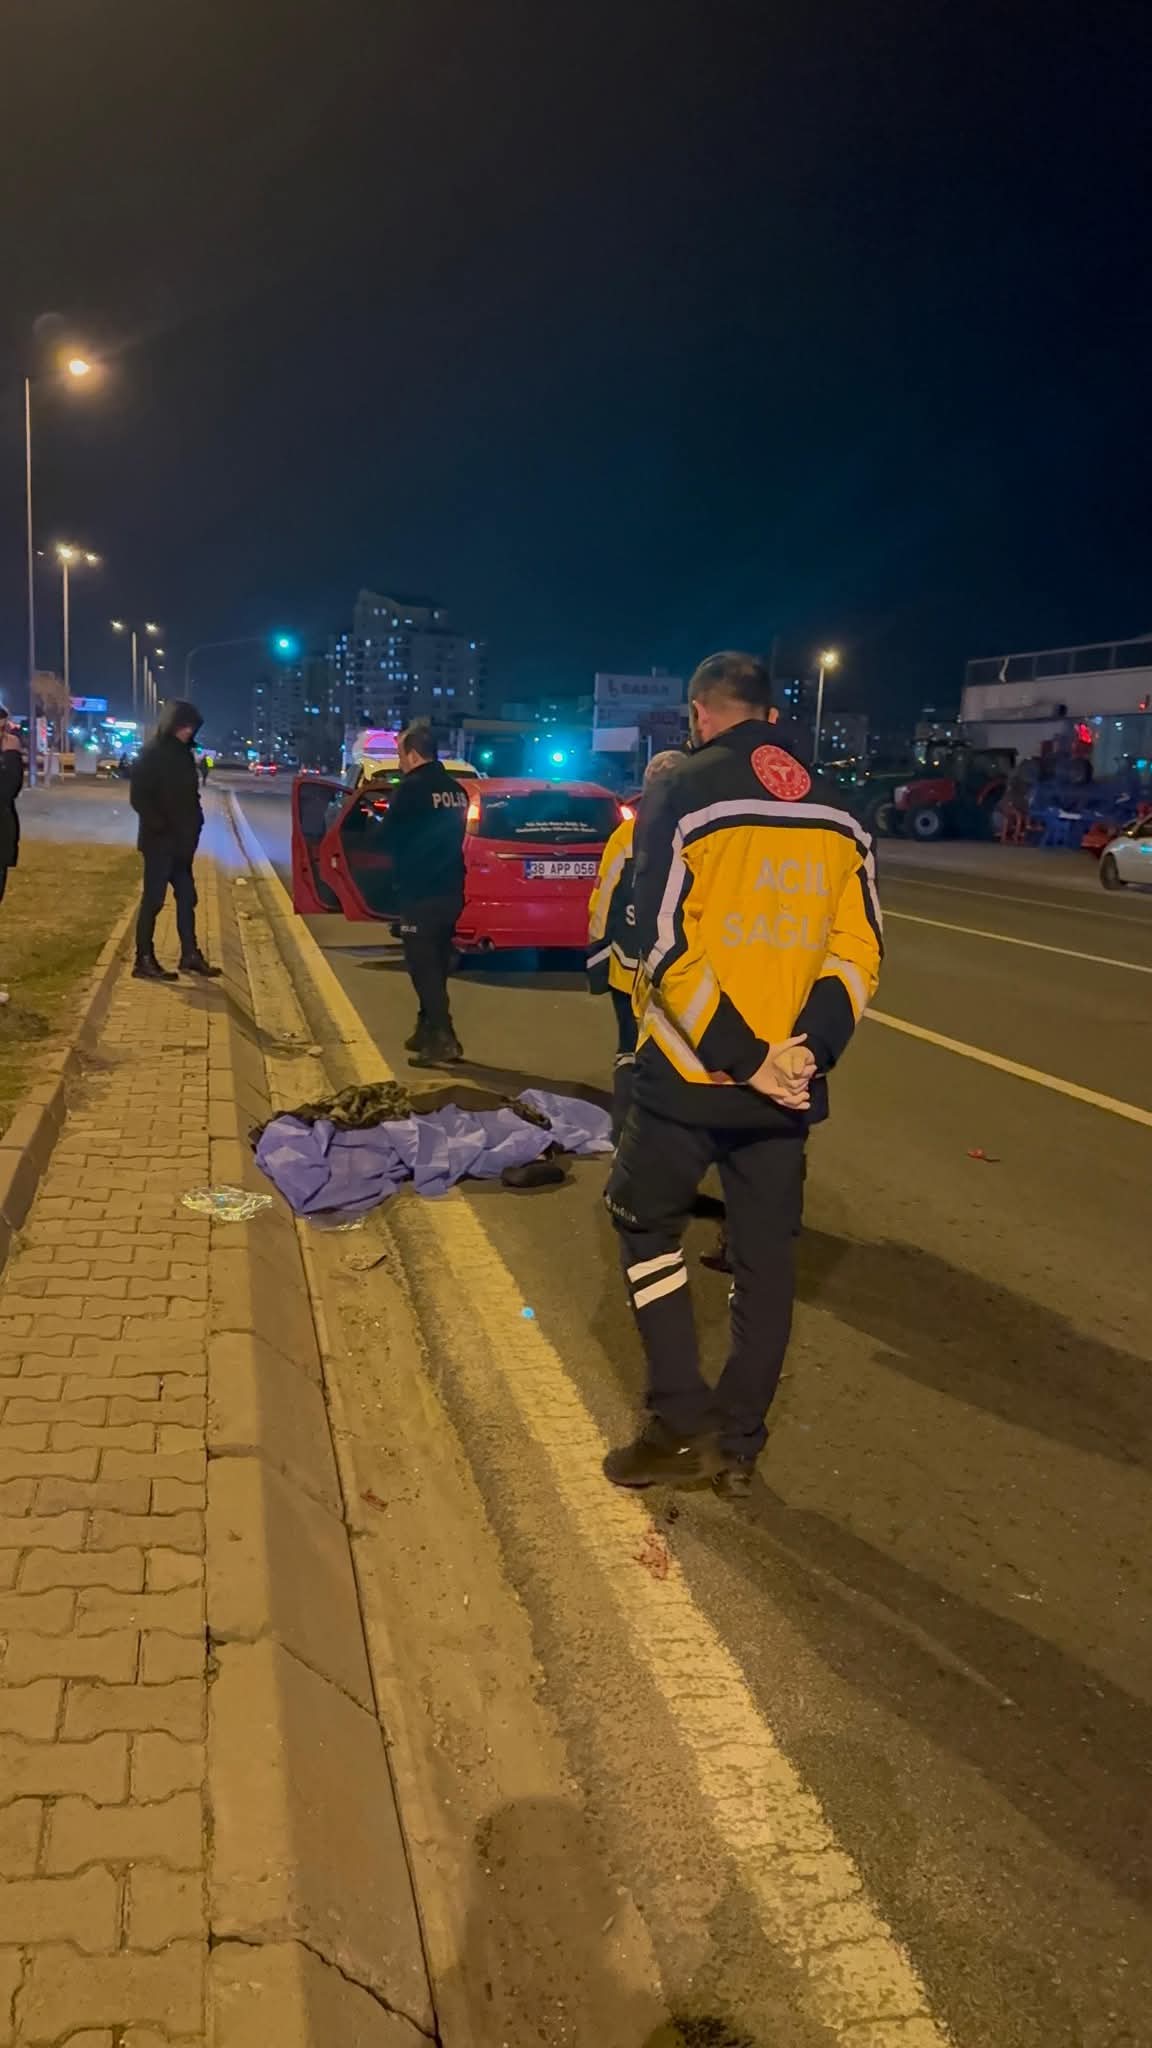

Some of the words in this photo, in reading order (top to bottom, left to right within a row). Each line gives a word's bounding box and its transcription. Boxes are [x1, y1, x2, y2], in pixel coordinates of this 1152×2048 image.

[532, 863, 545, 874] 38
[550, 863, 571, 874] APP
[574, 863, 594, 874] 056
